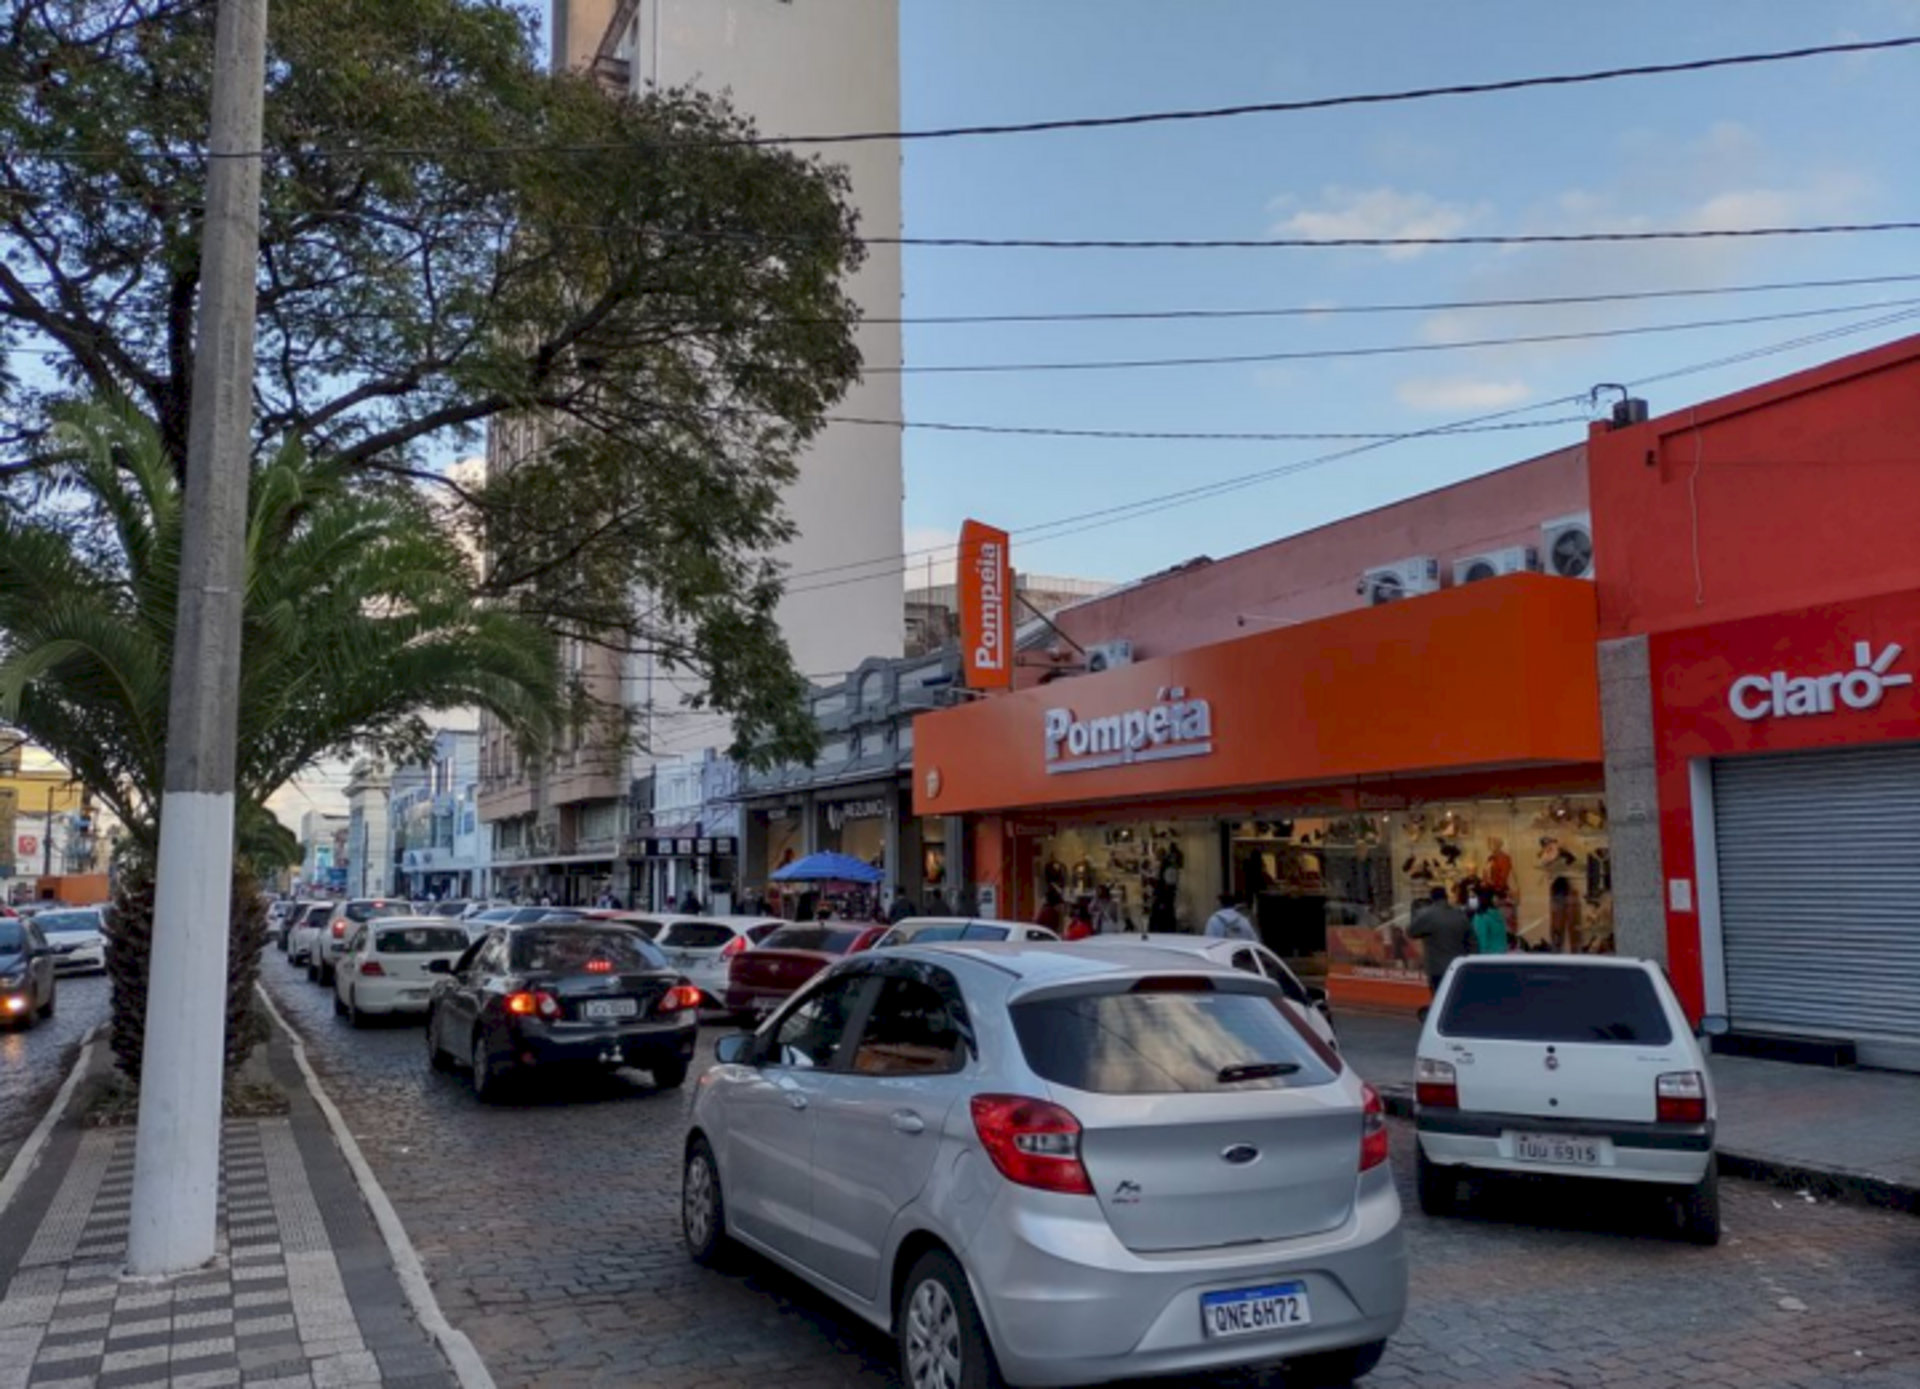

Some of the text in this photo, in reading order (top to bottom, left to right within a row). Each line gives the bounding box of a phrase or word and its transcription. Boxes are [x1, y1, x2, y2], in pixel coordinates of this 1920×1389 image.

[975, 542, 1002, 669] Pompéia
[1045, 686, 1212, 768] Pompéia
[1728, 669, 1884, 721] Claro
